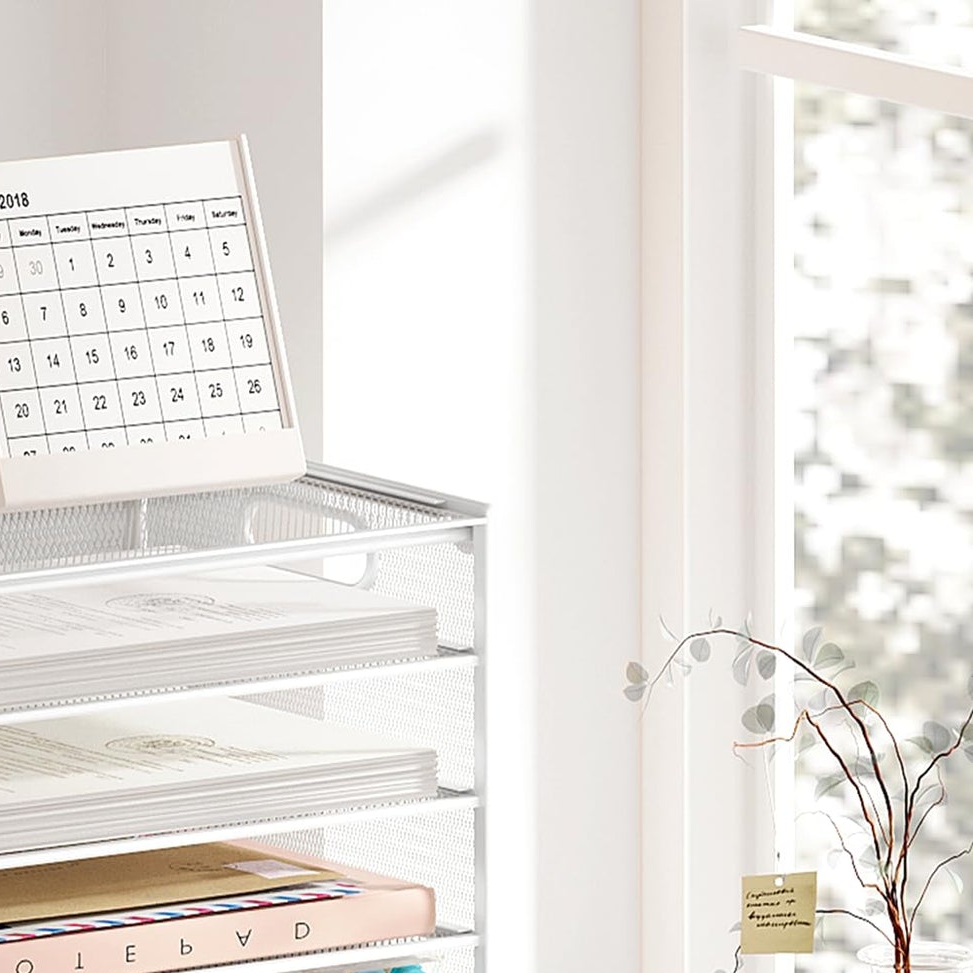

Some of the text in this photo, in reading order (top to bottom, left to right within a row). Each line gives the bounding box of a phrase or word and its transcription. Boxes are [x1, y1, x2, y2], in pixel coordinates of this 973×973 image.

[0, 192, 29, 210] 2018
[19, 229, 41, 237] Monday
[55, 226, 81, 234] Tuesday
[92, 221, 125, 229] Wednesday
[134, 218, 161, 226] Thursday
[29, 260, 43, 275] 30
[69, 258, 74, 271] 1
[107, 253, 114, 267] 2
[145, 249, 153, 264] 3
[185, 246, 191, 259] 4
[222, 241, 230, 256] 5
[1, 287, 244, 325] 6 7 8 9 10 11 12
[8, 334, 253, 372] 13 14 15 16 17 18 19
[15, 379, 262, 418] 20 21 22 23 24 25 26
